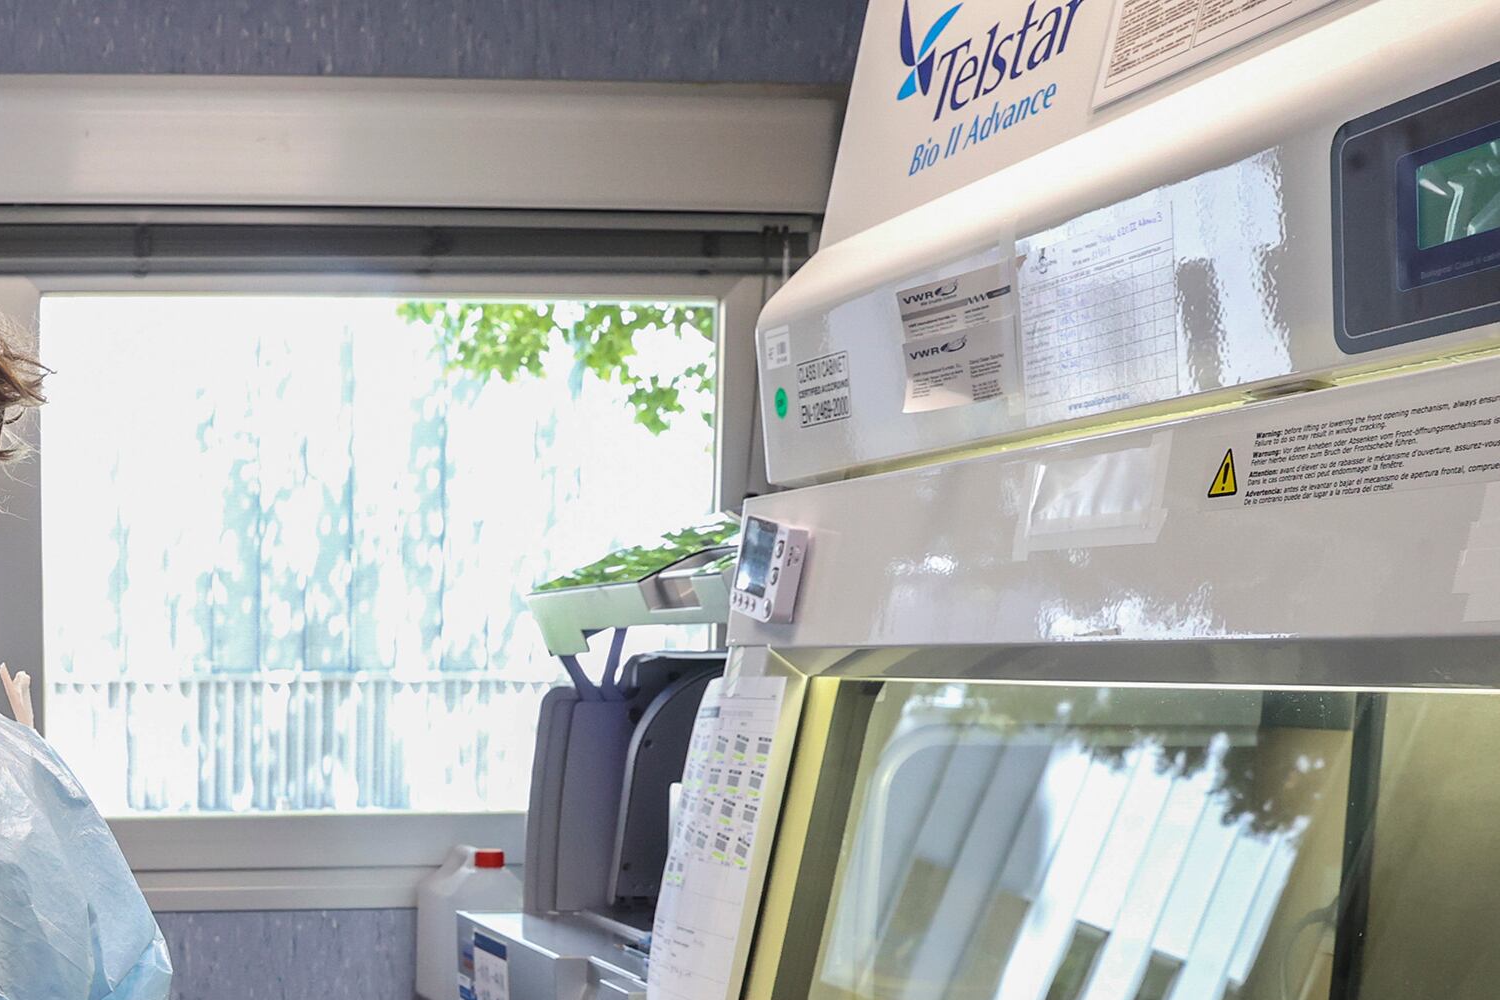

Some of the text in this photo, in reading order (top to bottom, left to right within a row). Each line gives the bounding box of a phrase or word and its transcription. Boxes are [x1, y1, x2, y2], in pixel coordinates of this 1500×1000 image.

[933, 0, 1085, 122] Telstar
[908, 137, 940, 177] Bio
[962, 83, 1057, 150] Advance
[903, 290, 934, 305] VWR
[909, 346, 940, 361] VWR
[1257, 430, 1282, 439] Warning:
[1284, 427, 1302, 435] before
[1329, 419, 1353, 427] lowering
[1384, 410, 1409, 419] opening
[1411, 403, 1450, 415] mechanism,
[1453, 399, 1477, 408] always
[1253, 449, 1281, 458] Warnung:
[1307, 441, 1332, 450] Anheben
[1348, 434, 1378, 444] Absenken
[1255, 439, 1272, 447] Failure
[1310, 431, 1327, 439] result
[1335, 426, 1357, 435] window
[1359, 421, 1386, 431] cracking.
[1324, 448, 1340, 456] Bruch
[1245, 488, 1282, 497] Advertencia:
[1309, 482, 1332, 490] levantar
[1364, 474, 1398, 484] mecanismo
[1410, 469, 1438, 479] apertura
[1249, 469, 1278, 478] Attention:
[1284, 494, 1301, 502] puede
[1362, 485, 1371, 493] del
